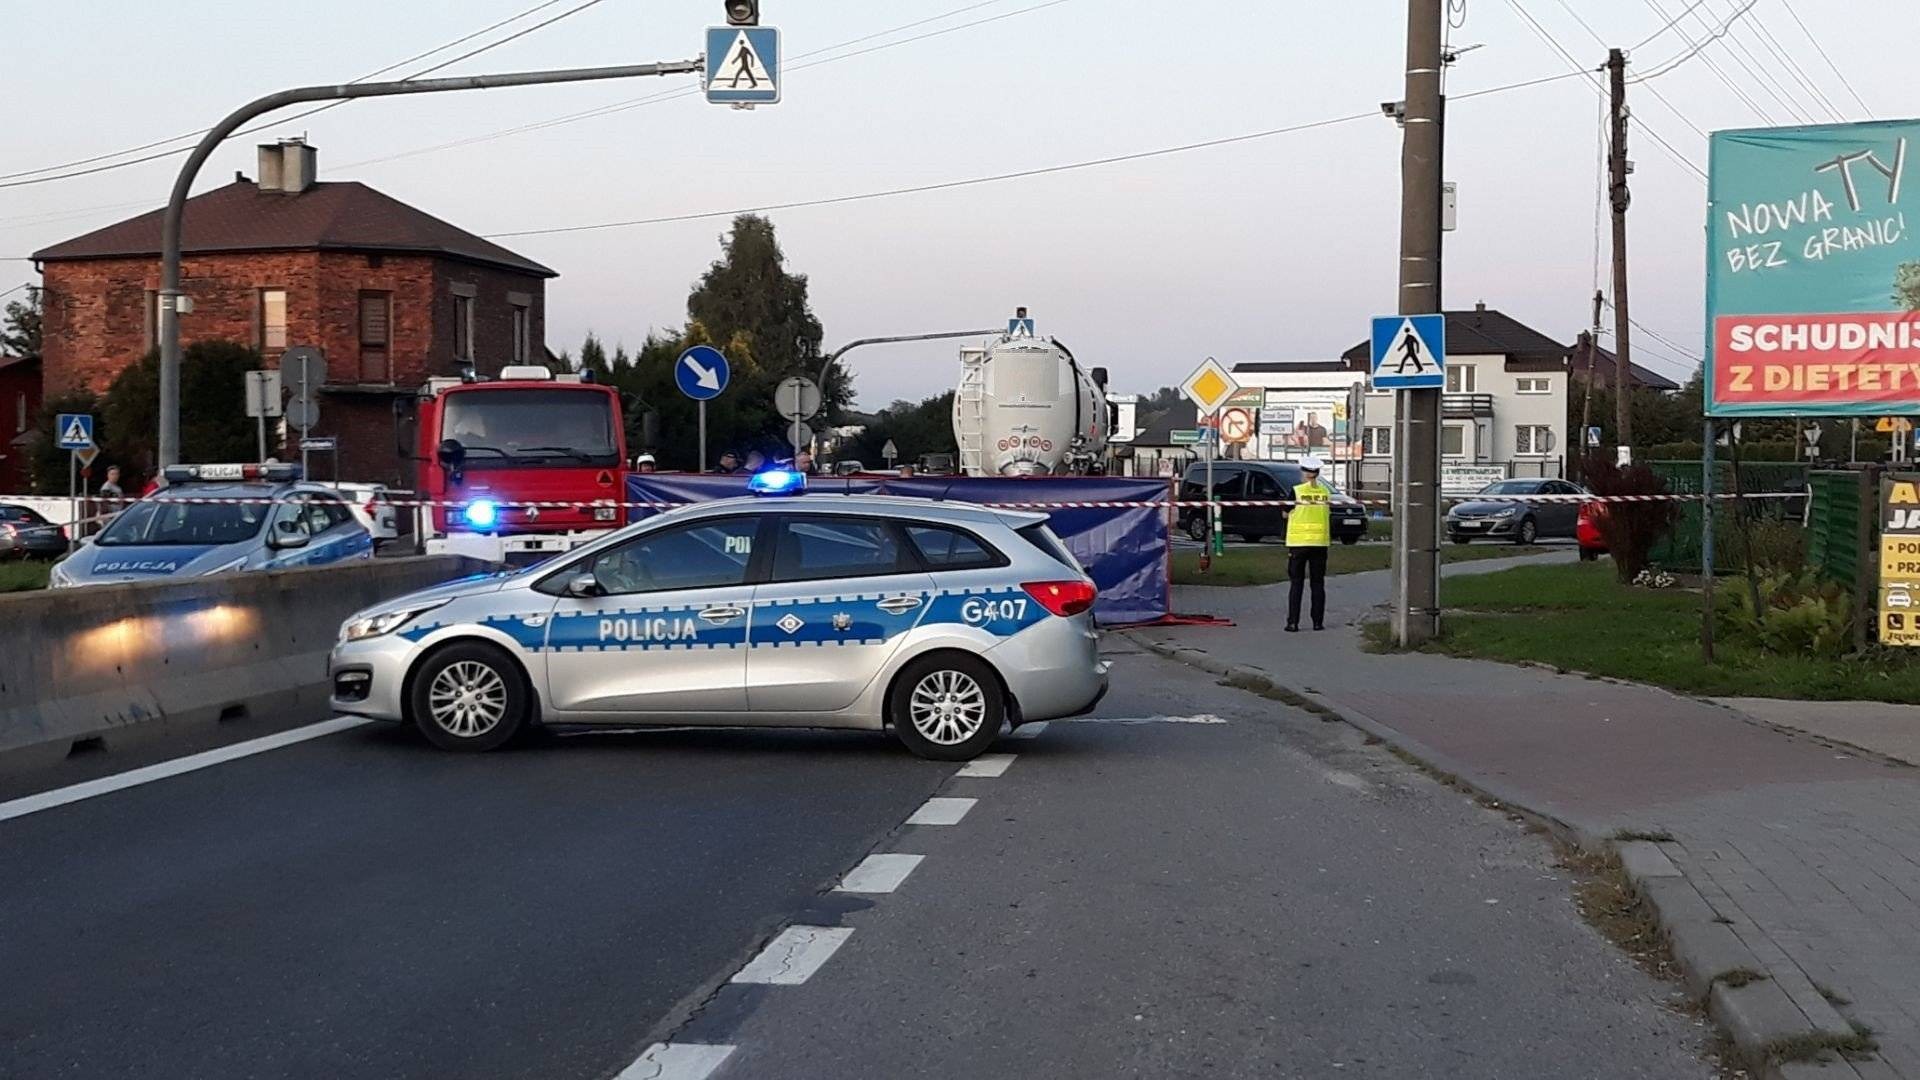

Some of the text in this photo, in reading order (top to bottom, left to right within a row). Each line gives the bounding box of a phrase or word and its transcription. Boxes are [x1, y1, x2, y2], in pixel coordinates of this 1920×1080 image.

[1727, 137, 1907, 239] NOWA TY
[1727, 212, 1908, 272] BEZ GRANIC!
[1729, 365, 1753, 392] Z
[1888, 482, 1920, 504] A
[1898, 542, 1920, 554] PO
[94, 561, 176, 572] POLICJA
[962, 599, 1027, 622] G407
[600, 618, 697, 641] POLICJA
